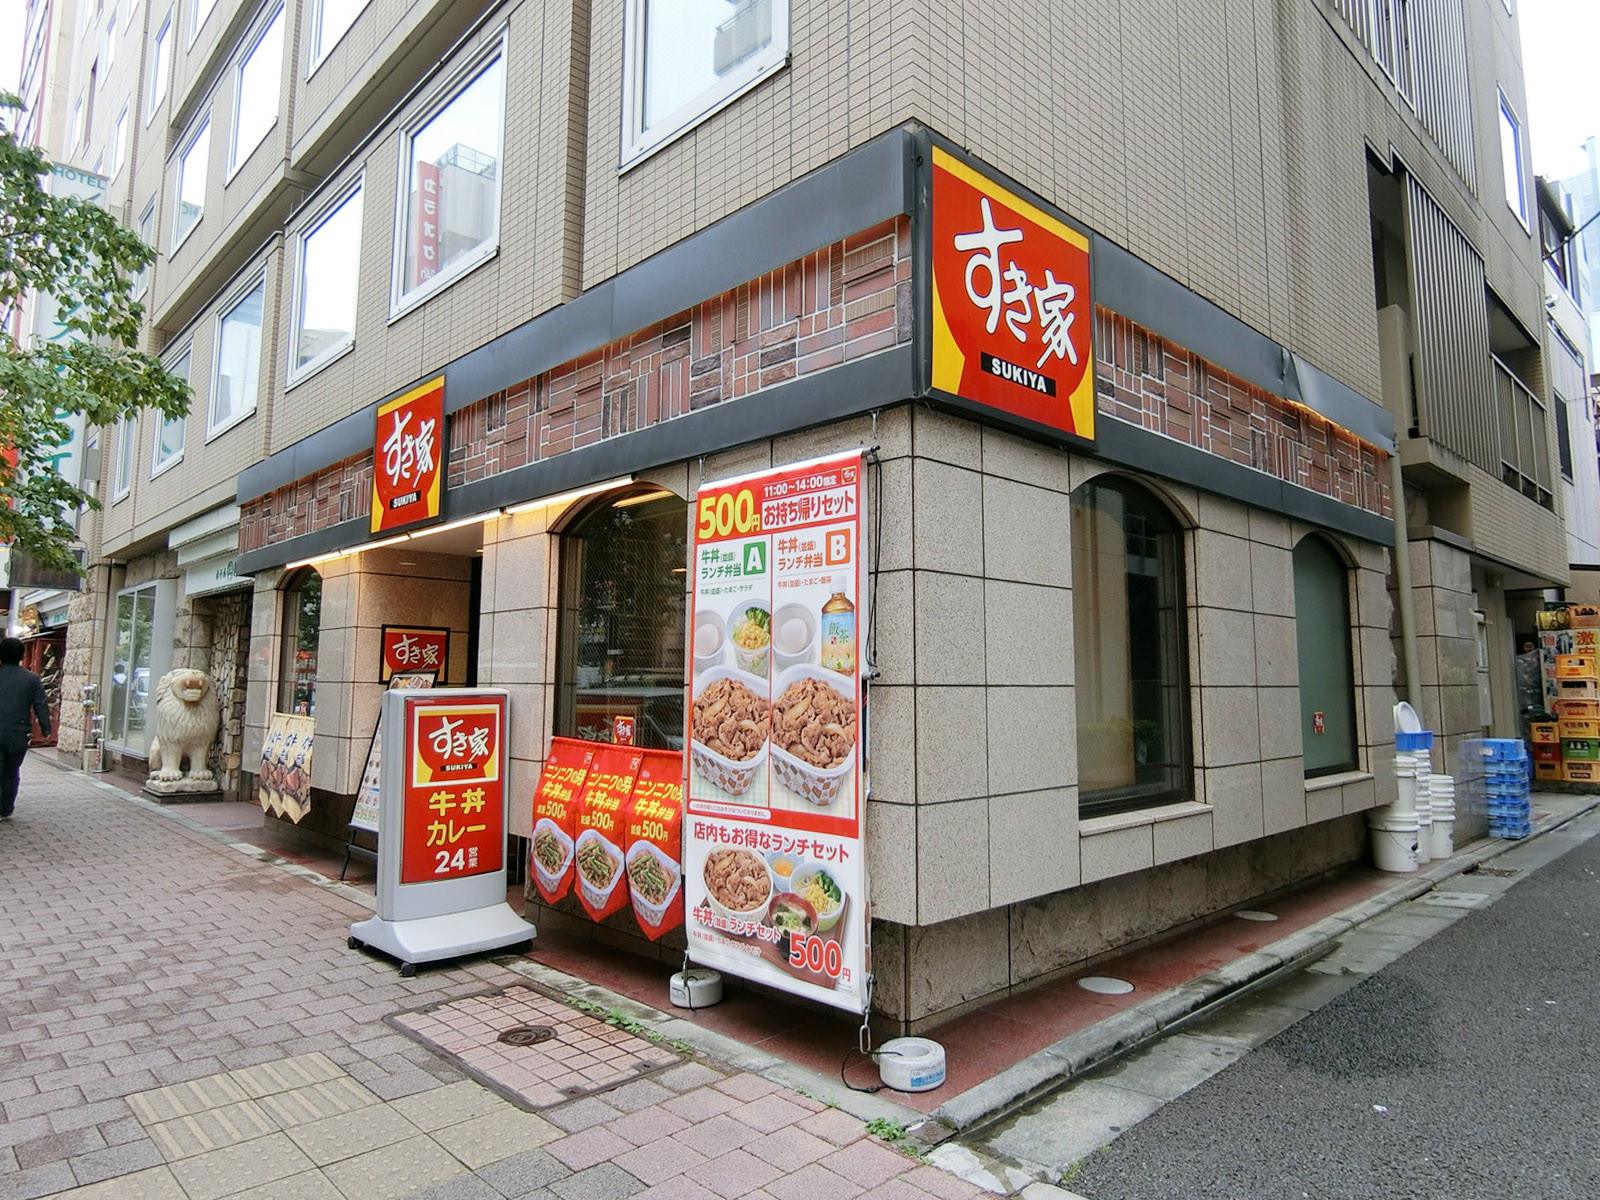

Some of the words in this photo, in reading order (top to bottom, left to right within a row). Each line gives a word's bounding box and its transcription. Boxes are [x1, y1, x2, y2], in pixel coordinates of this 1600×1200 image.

[53, 165, 106, 190] HOTEL
[954, 196, 1079, 369] すき家
[991, 357, 1047, 393] SUKIYA
[383, 410, 435, 488] すき家
[393, 492, 418, 508] SUKIYA
[764, 490, 854, 527] お持ち帰りセット
[701, 563, 741, 579] ランチ弁当
[778, 552, 823, 571] ランチ弁当
[392, 634, 440, 668] すき家
[428, 716, 489, 762] すき家
[445, 763, 474, 771] SUKIYA
[542, 780, 573, 802] 牛丼弁当
[587, 773, 634, 794] ニンニクの芽
[429, 787, 486, 817] 牛丼
[585, 789, 621, 811] 牛丼弁当
[634, 797, 676, 821] 牛丼弁当
[426, 819, 487, 847] カレー
[694, 821, 849, 863] 店内もお得なランチセット
[434, 847, 466, 873] 24
